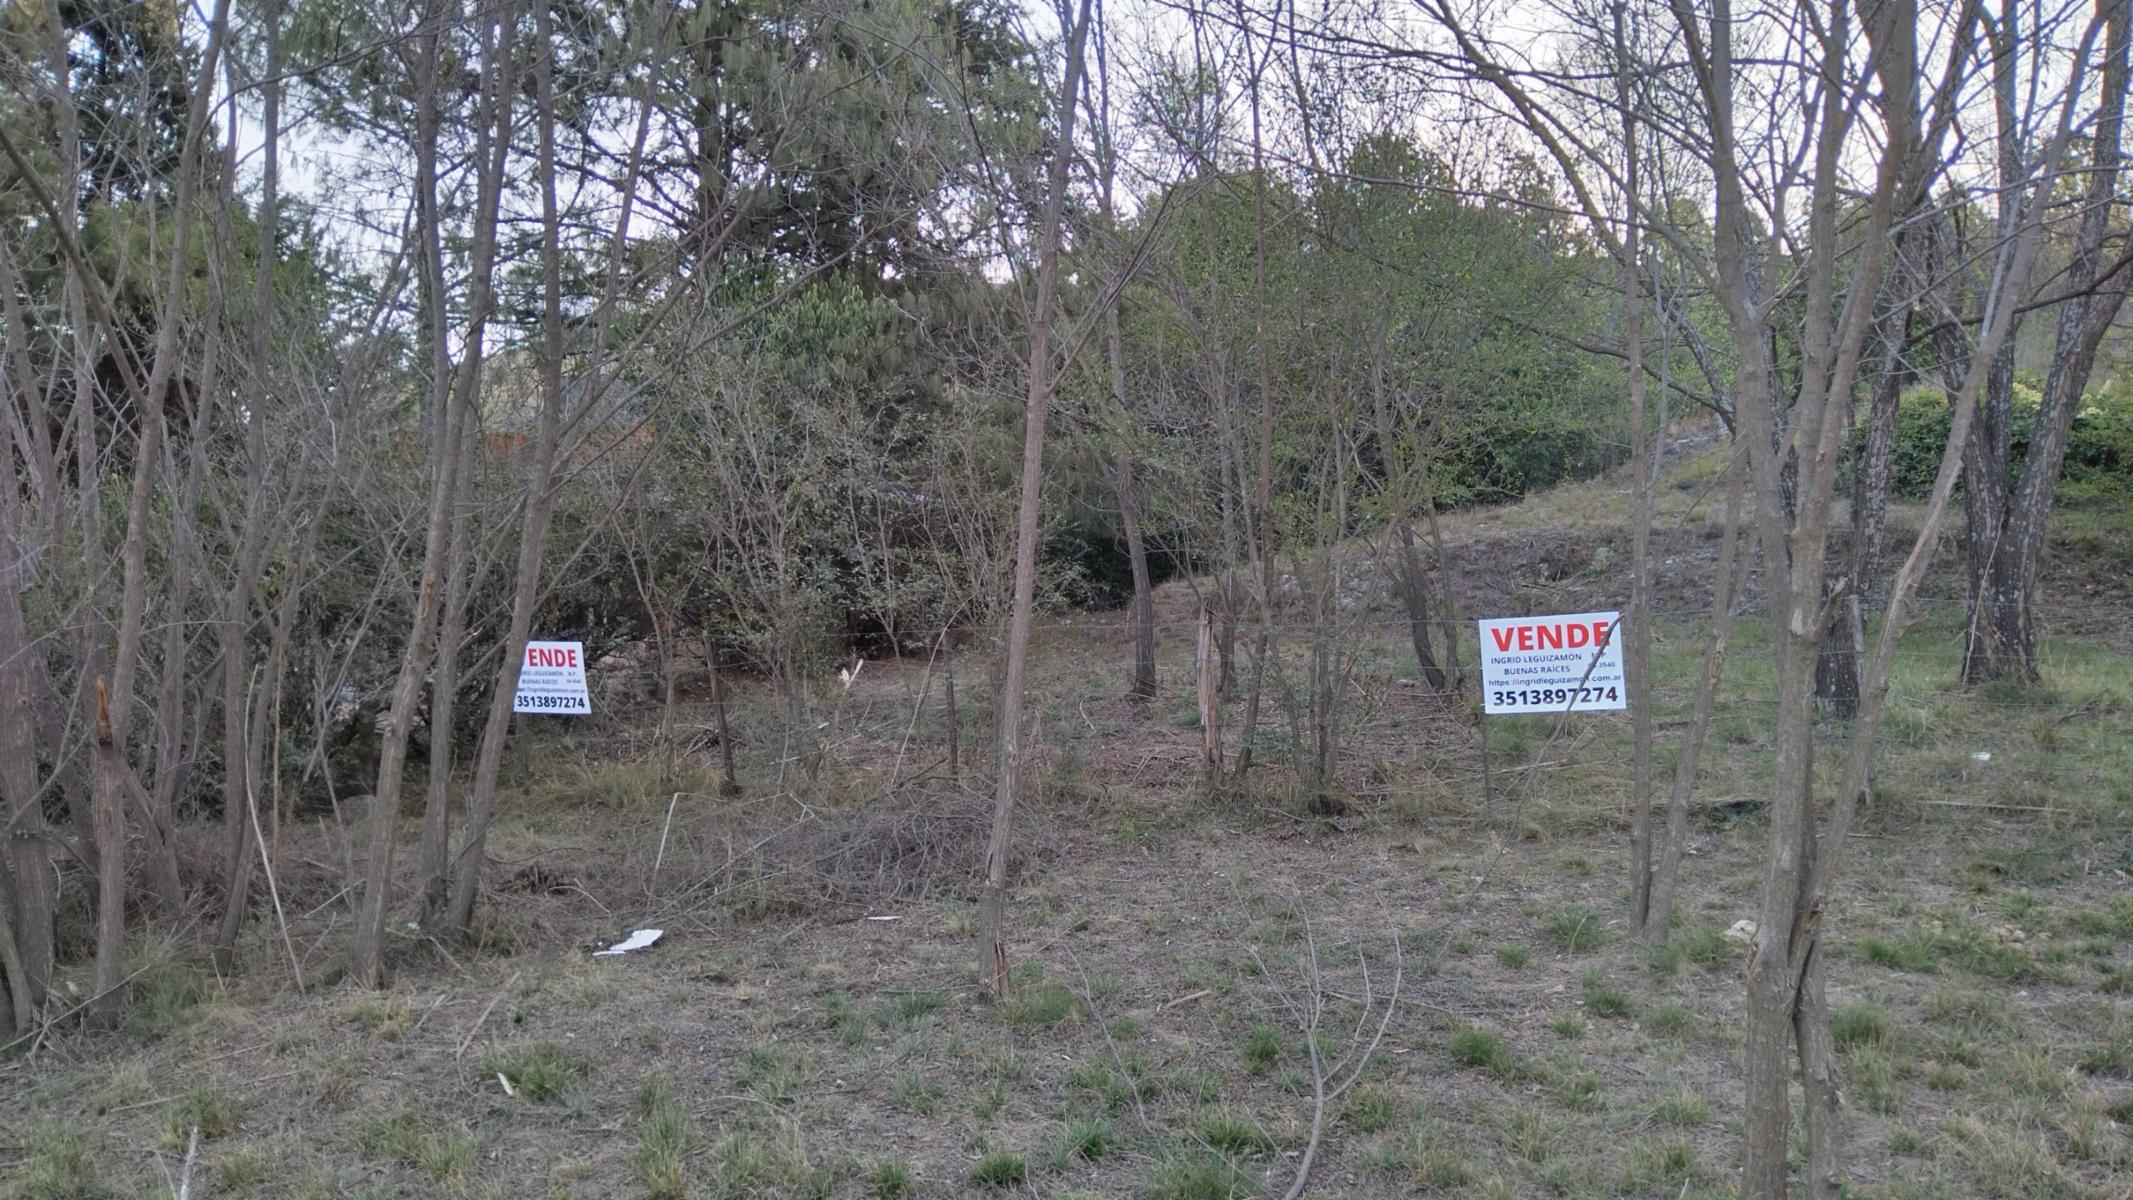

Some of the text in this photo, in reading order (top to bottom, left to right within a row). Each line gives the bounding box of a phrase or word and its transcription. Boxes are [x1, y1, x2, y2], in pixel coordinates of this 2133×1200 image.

[1490, 621, 1612, 652] VENDE
[527, 648, 578, 668] ENDE
[1490, 656, 1521, 665] INGRID
[1523, 652, 1582, 664] LEGUIZAMÓN
[1504, 664, 1571, 676] BUENAS RAÍCES
[517, 695, 585, 708] 3513897274
[1493, 686, 1618, 707] 3513897274
